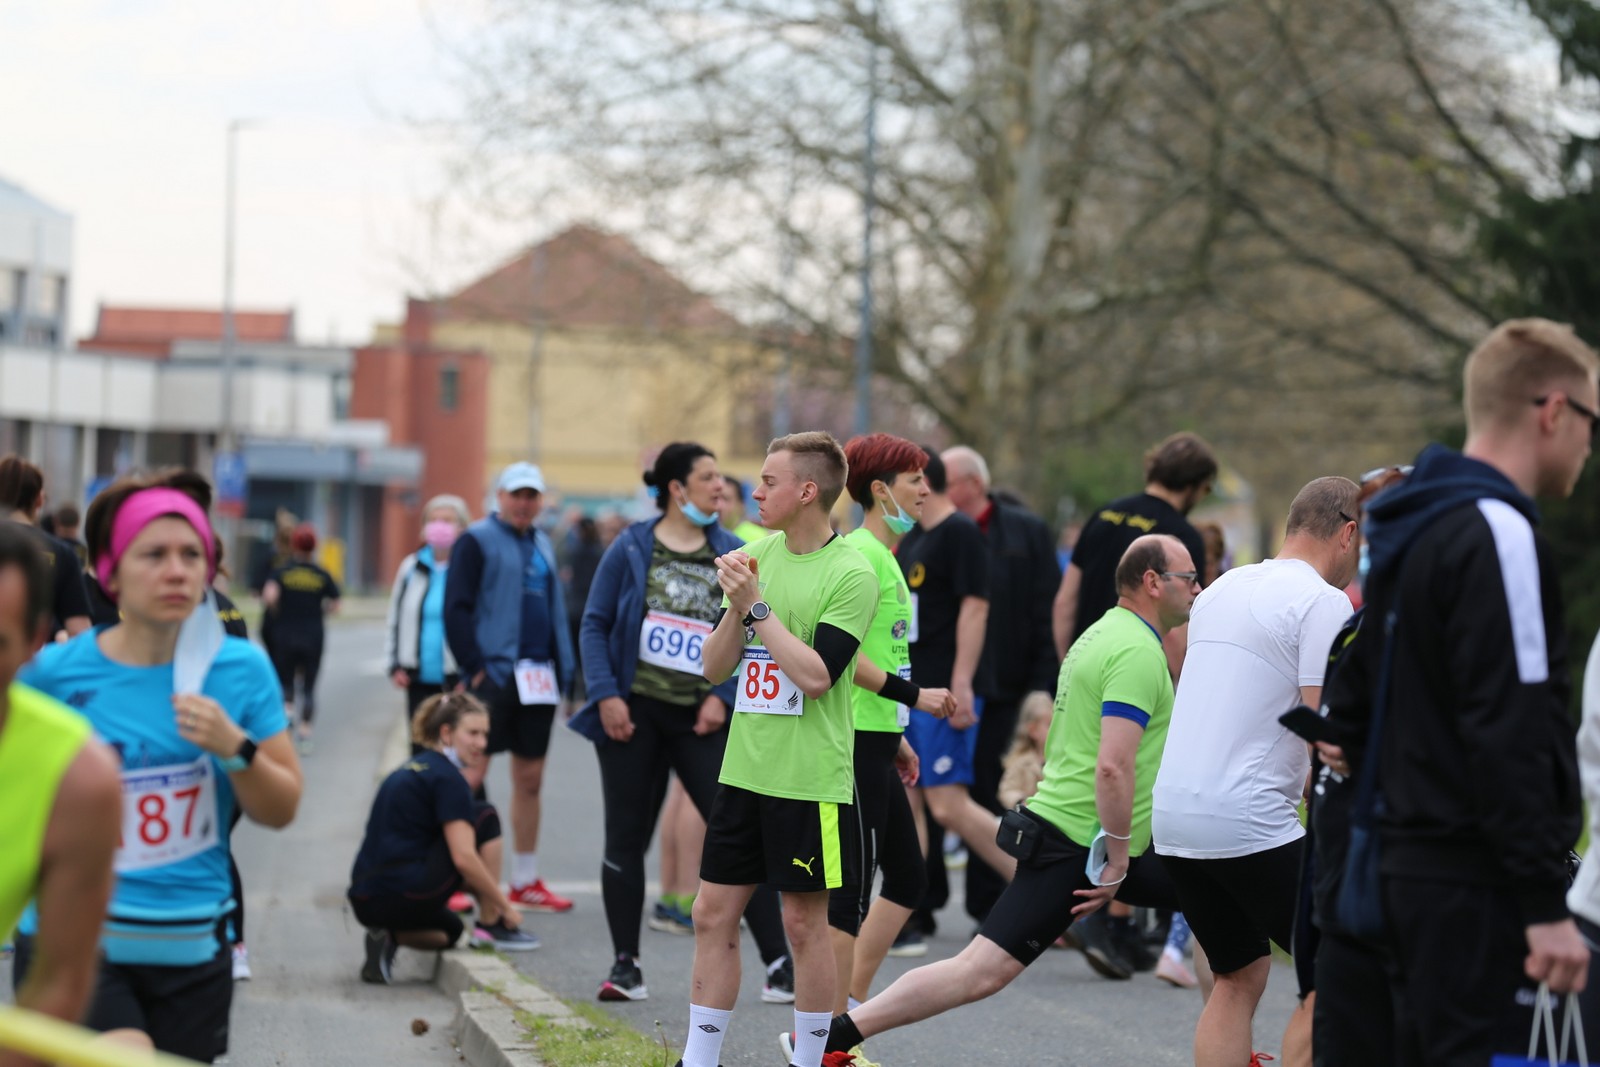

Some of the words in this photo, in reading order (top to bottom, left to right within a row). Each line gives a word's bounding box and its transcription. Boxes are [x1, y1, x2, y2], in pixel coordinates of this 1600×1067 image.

[648, 626, 702, 661] 696
[745, 661, 780, 700] 85
[119, 785, 202, 848] 87
